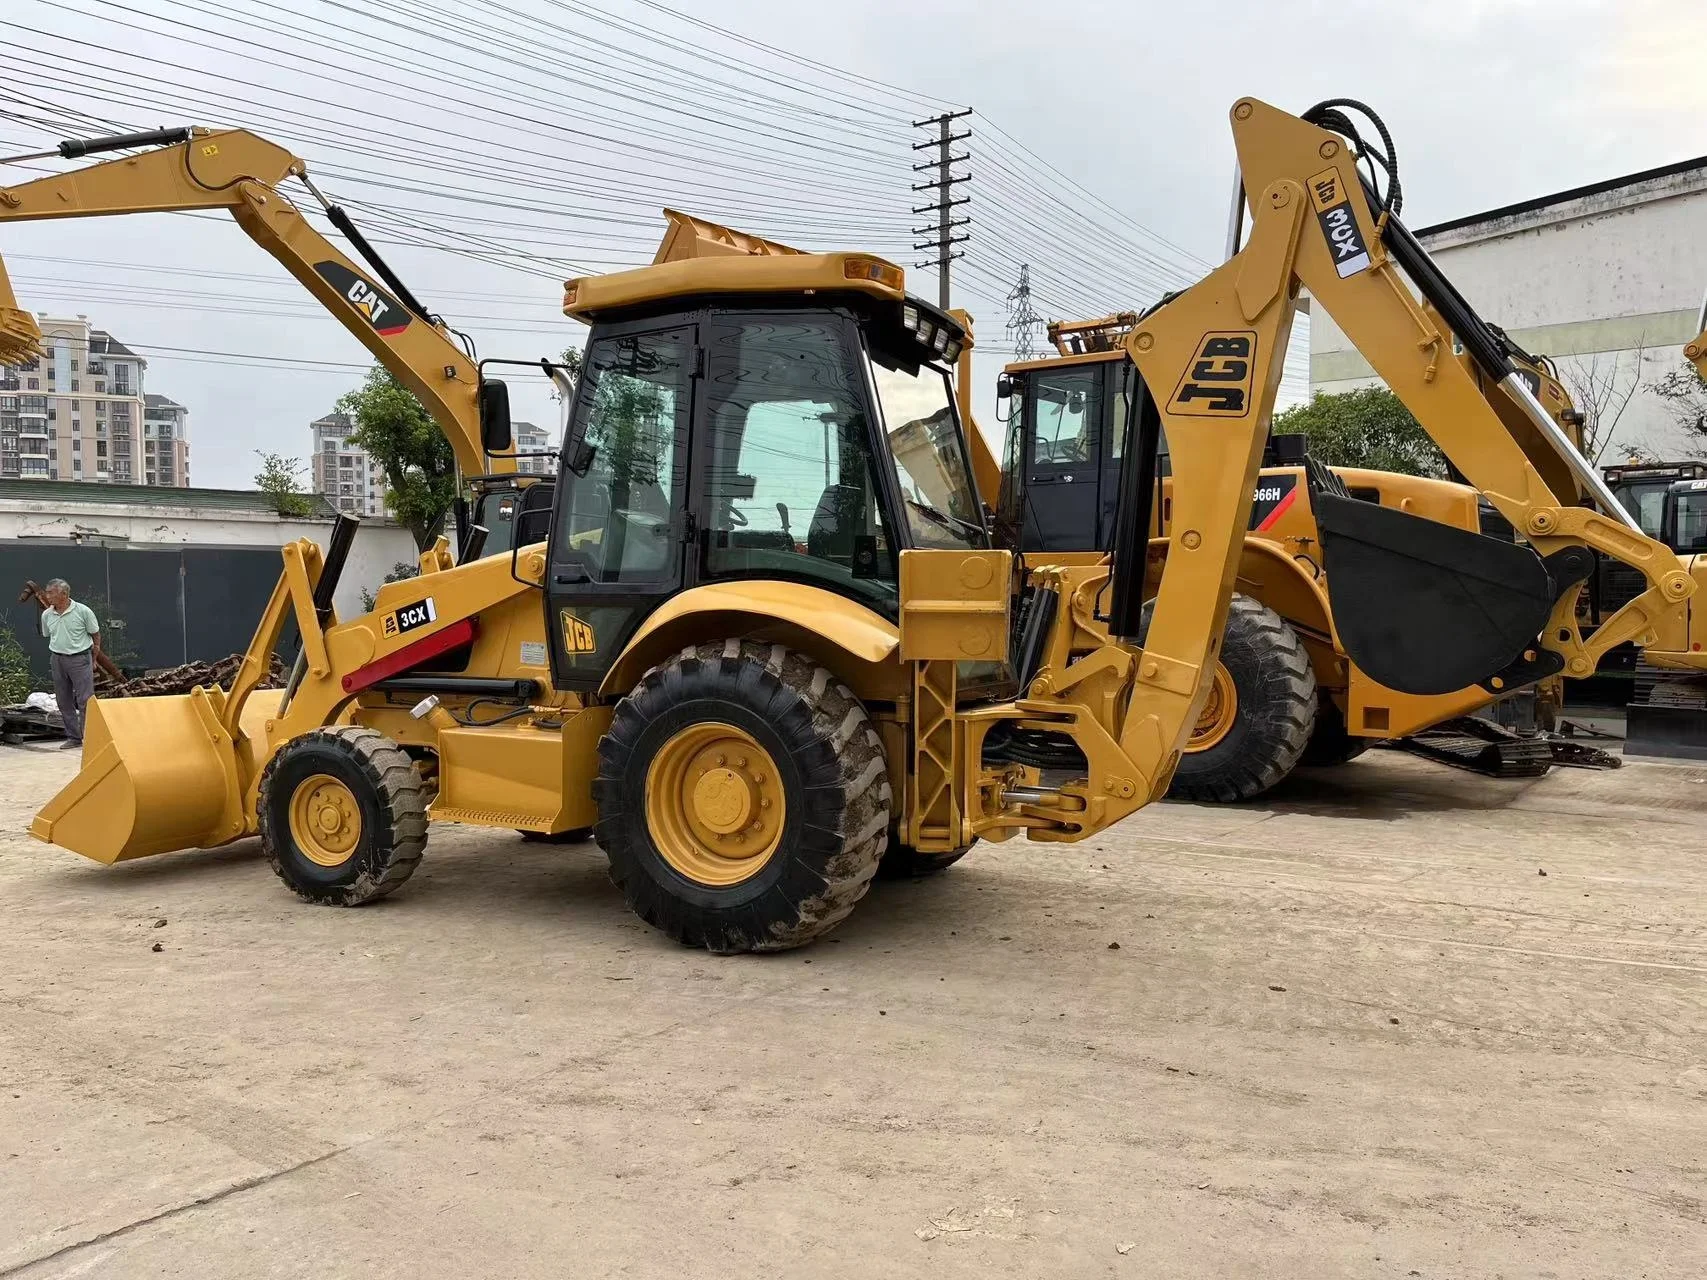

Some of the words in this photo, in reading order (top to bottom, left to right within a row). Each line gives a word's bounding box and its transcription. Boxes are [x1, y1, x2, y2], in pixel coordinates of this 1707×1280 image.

[1315, 178, 1335, 204] JCB
[1326, 208, 1360, 258] 3CX
[347, 279, 389, 323] CAT
[1176, 337, 1250, 411] JCB
[1253, 488, 1281, 502] 966H
[401, 606, 426, 627] 3CX
[565, 615, 593, 651] JCB
